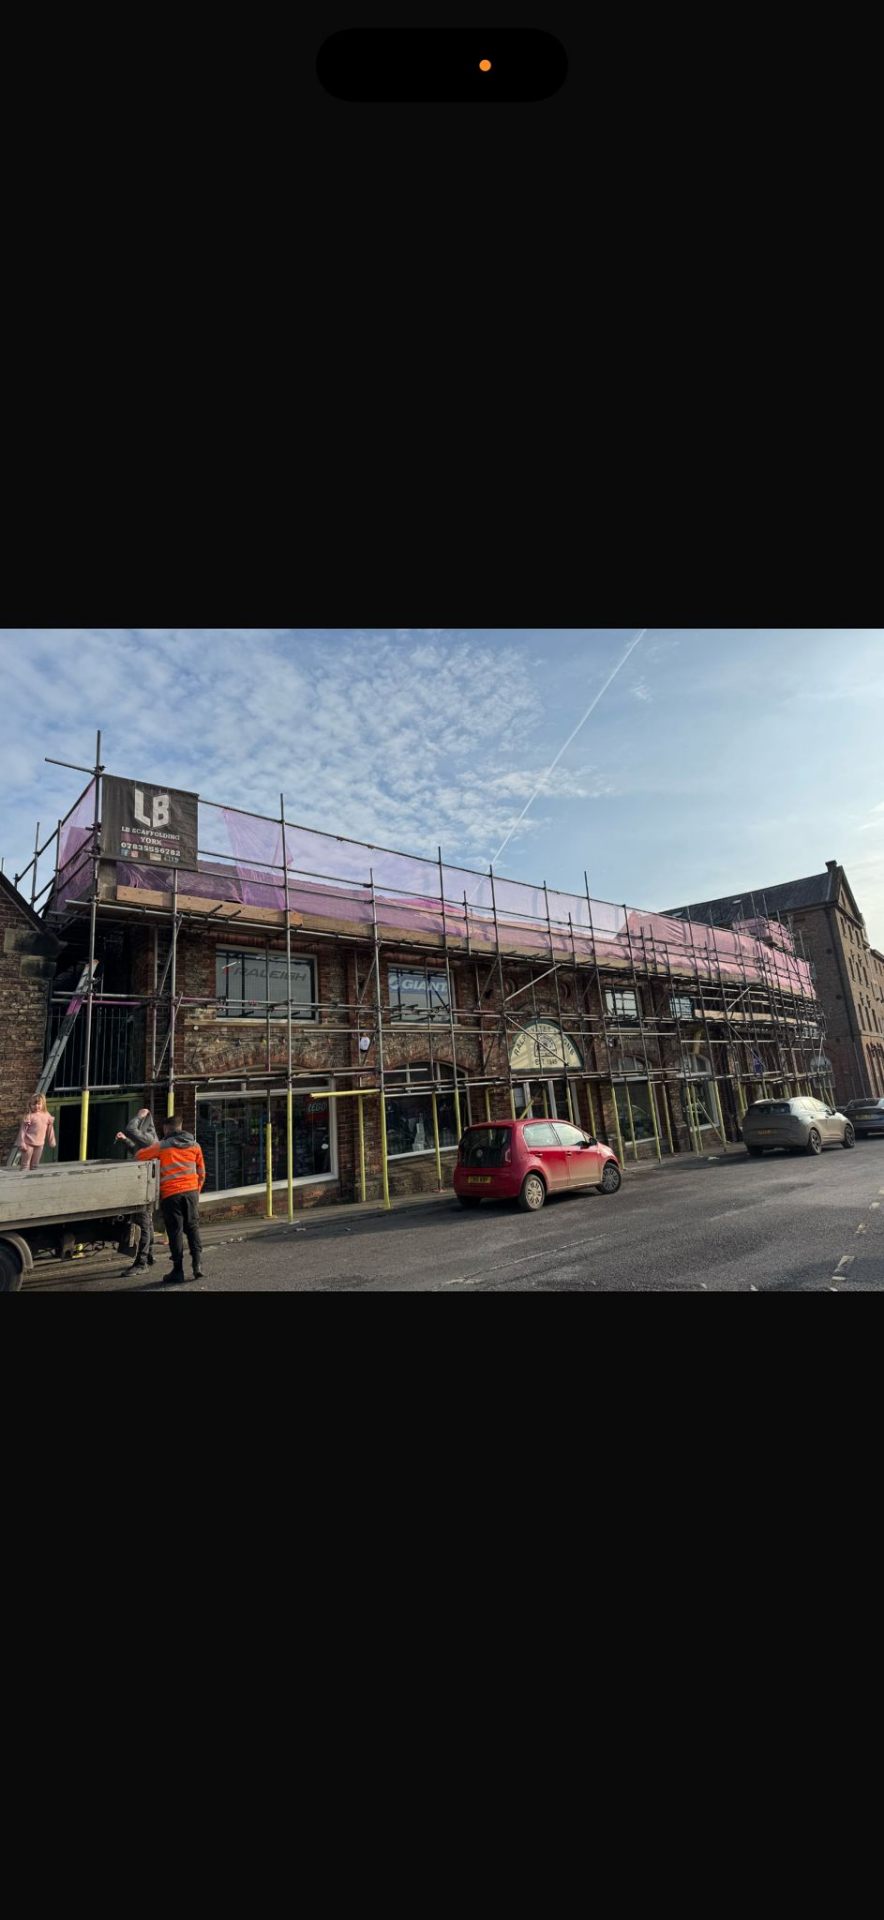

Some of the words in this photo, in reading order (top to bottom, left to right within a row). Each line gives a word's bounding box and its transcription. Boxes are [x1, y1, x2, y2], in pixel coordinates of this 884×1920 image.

[134, 788, 169, 828] LB
[132, 829, 180, 841] SCAFFOLDING
[140, 837, 162, 845] YORK
[402, 979, 448, 993] GIANT
